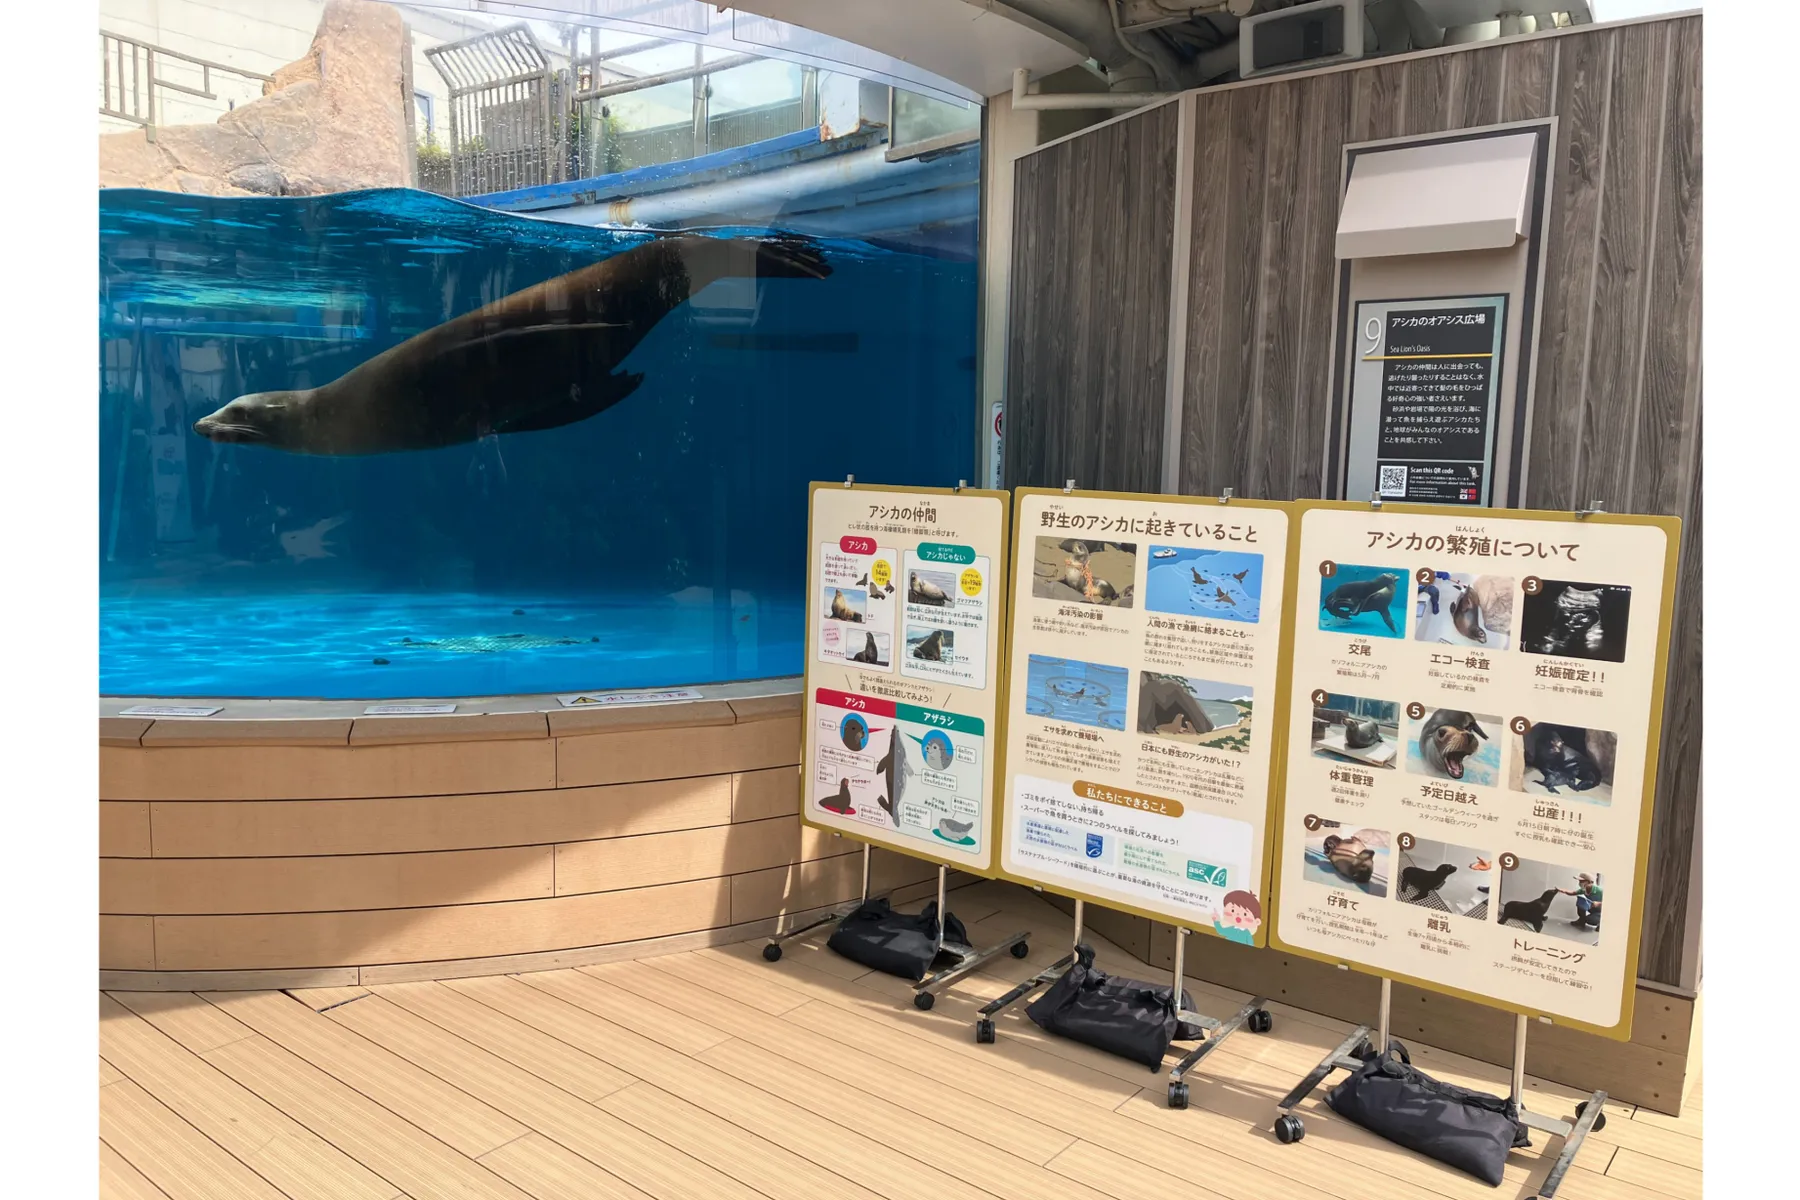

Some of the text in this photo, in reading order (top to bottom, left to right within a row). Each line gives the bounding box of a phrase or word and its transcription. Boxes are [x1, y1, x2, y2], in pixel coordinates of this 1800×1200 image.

[1392, 313, 1486, 328] アシカのオアシス広場
[1365, 317, 1382, 354] 9
[1390, 344, 1430, 353] Sea Lion's Oasis
[1395, 362, 1484, 371] アシカの仲間は人に出会っても、
[1384, 426, 1480, 434] と、地球がみんなのオアシスである
[1384, 436, 1442, 444] ことを共感して下さい。
[869, 505, 936, 523] アシカの仲間
[1041, 511, 1257, 542] 野生のアシカに起きていること
[848, 541, 868, 550] アシカ
[1367, 531, 1580, 561] アシカの繁殖について
[926, 552, 966, 562] アシカじゃない
[1324, 564, 1331, 574] 1
[1420, 572, 1430, 583] 2
[1527, 580, 1537, 592] 3
[1058, 608, 1104, 620] 海洋汚染の影響
[1147, 620, 1254, 638] 人間の漁で漁網に絡まることも…
[1348, 644, 1372, 656] 交尾
[1430, 654, 1490, 670] エコー検査
[1543, 659, 1584, 668] にんしんかくてい
[1535, 664, 1604, 683] 妊娠確定!!
[860, 684, 933, 703] 違いを徹底比較してみよう!
[1316, 693, 1324, 703] 4
[844, 697, 866, 709] アシカ
[1411, 706, 1420, 717] 5
[924, 712, 954, 726] アザラシ
[1516, 720, 1525, 732] 6
[1044, 725, 1104, 742] エサを求めて養殖場へ
[1330, 770, 1374, 788] 体重管理
[1086, 788, 1167, 814] 私たちにできること
[1420, 785, 1478, 806] 予定日越え
[1536, 799, 1560, 807] しゅっさん
[1532, 805, 1582, 824] 出産!!!
[1308, 818, 1316, 828] 7
[1402, 836, 1410, 848] 8
[1504, 856, 1514, 868] 9
[1188, 866, 1204, 875] asc
[1327, 895, 1359, 911] 仔育て
[1427, 918, 1452, 934] 離乳
[1514, 938, 1586, 964] トレーニング
